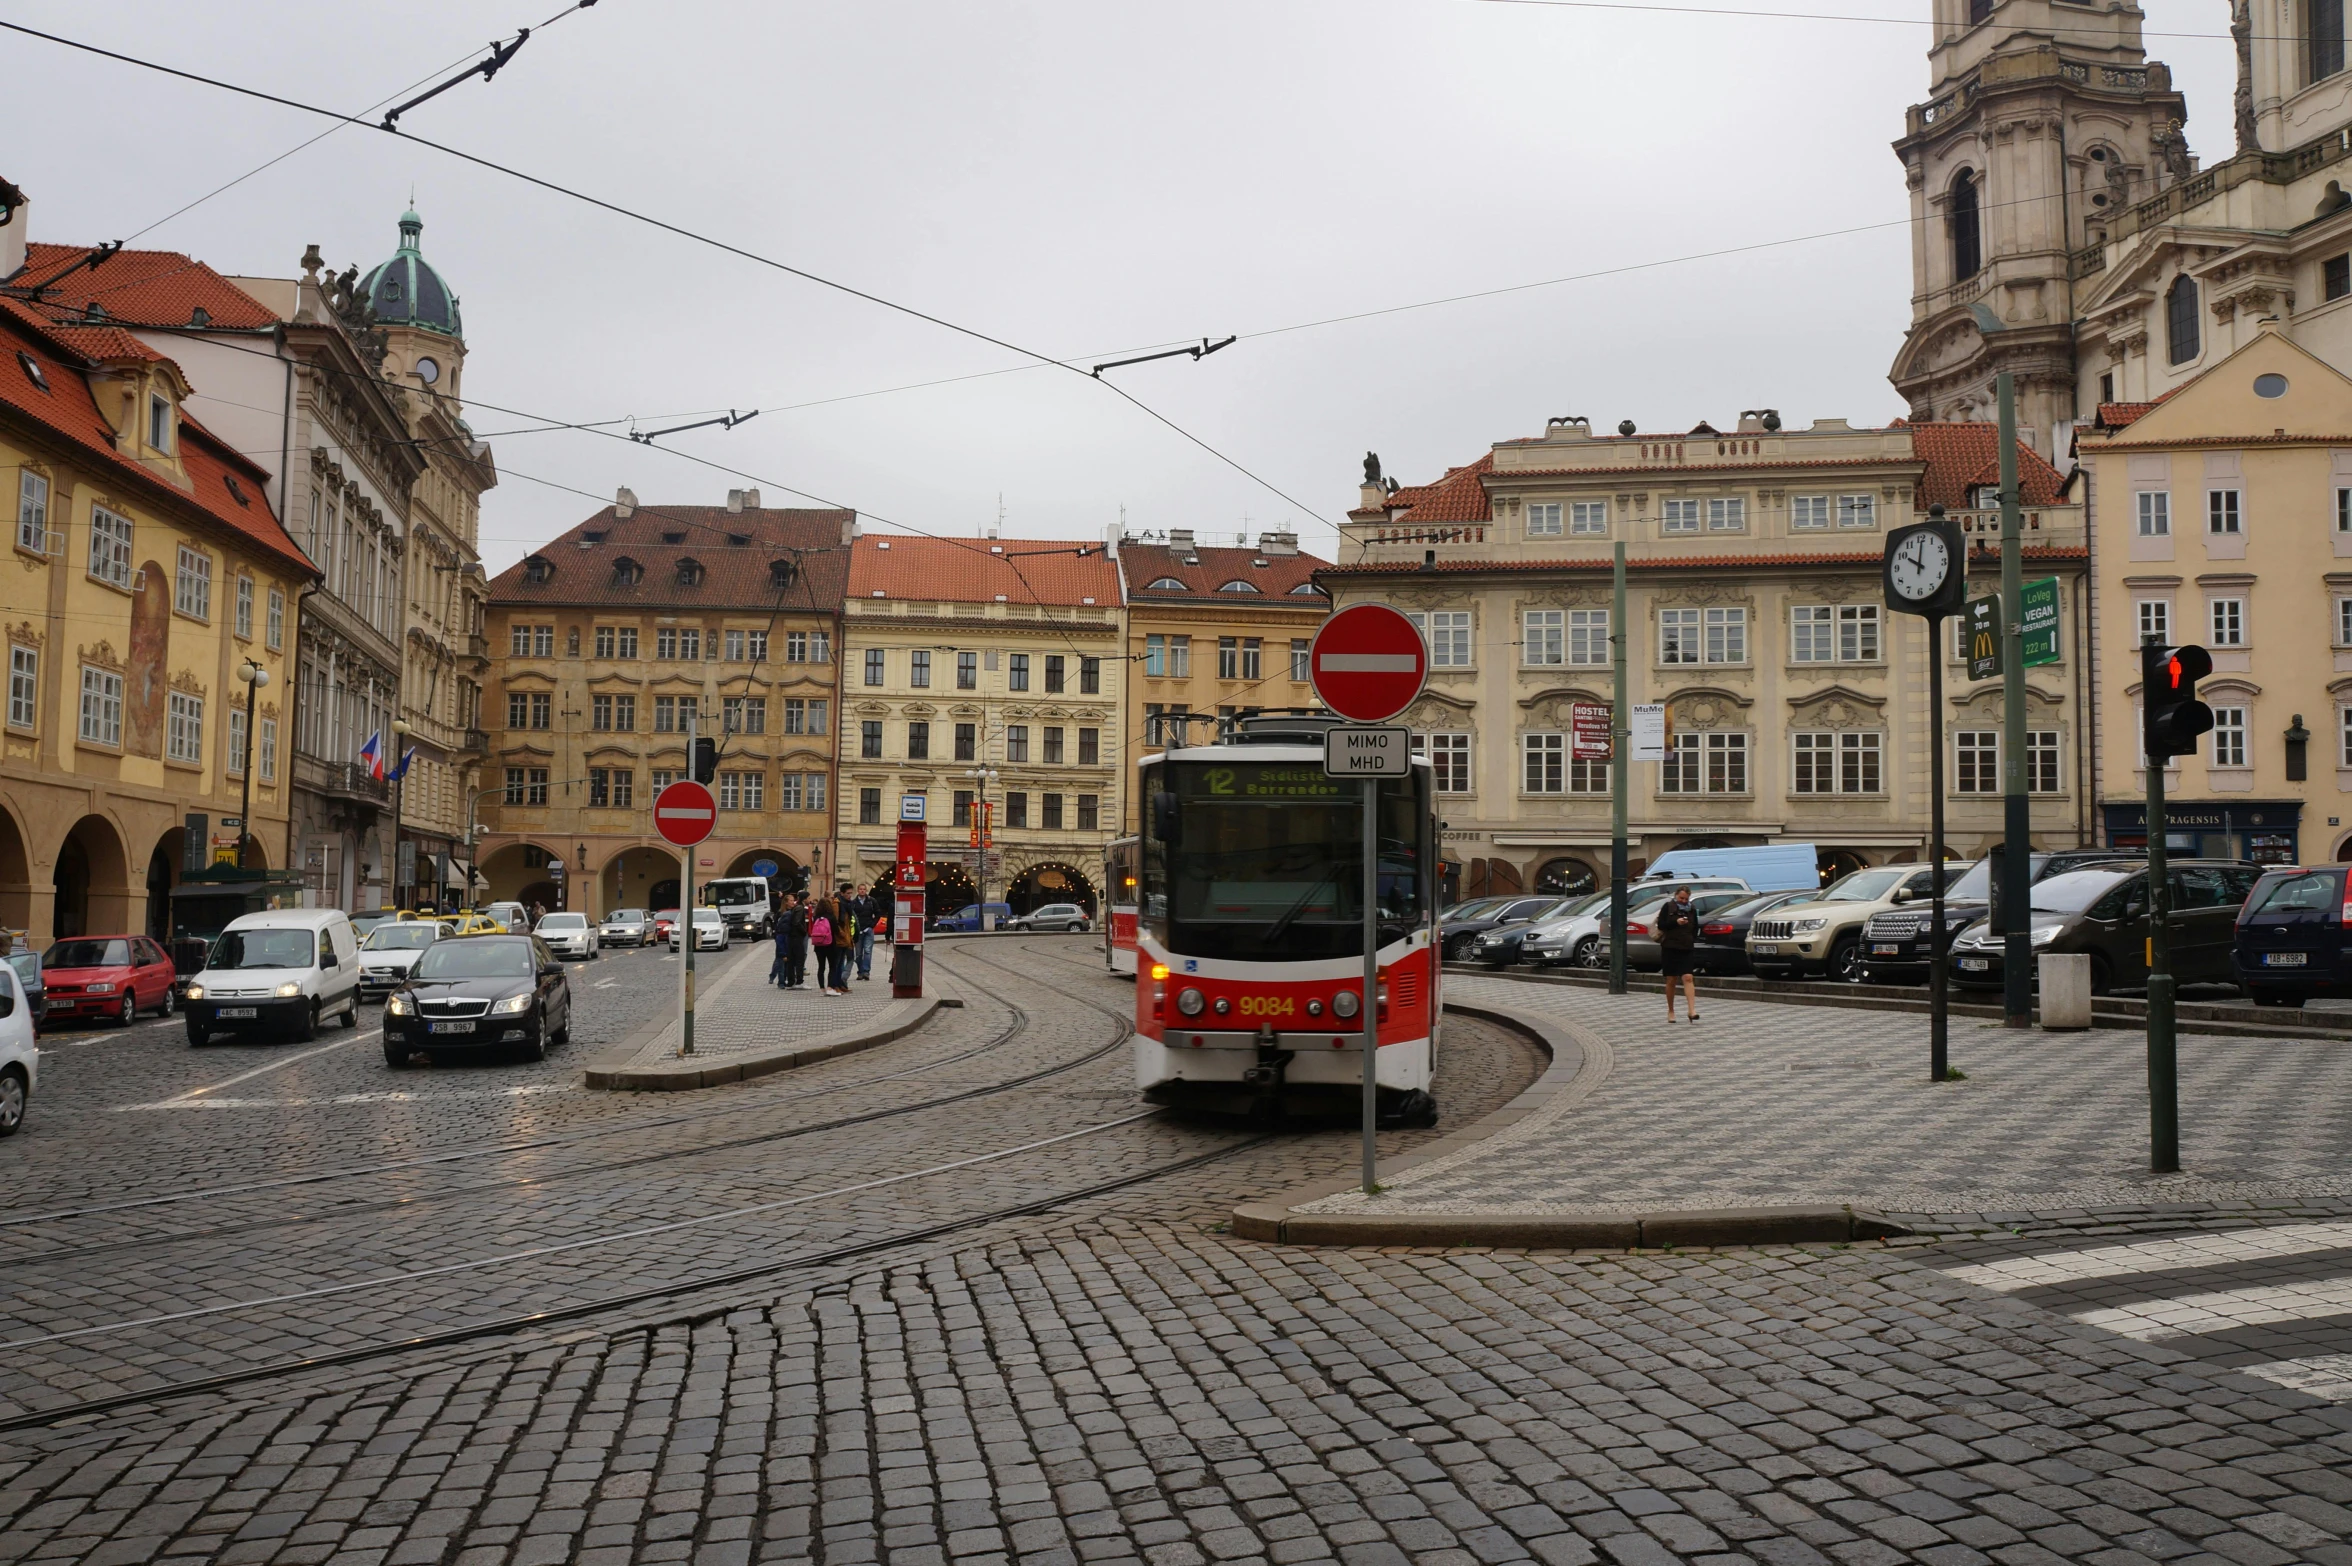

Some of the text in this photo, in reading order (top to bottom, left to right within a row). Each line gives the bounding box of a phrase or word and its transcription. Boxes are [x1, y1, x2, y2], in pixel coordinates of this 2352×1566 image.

[1916, 534, 1926, 543] 12
[1930, 536, 1934, 545] 1
[1906, 541, 1914, 549] 11
[1938, 545, 1944, 553] 2
[1898, 552, 1908, 560] 10
[1941, 558, 1947, 566] 3
[1936, 571, 1942, 580] 4
[1897, 577, 1904, 586] 8
[1906, 586, 1911, 594] 7
[1917, 588, 1923, 596] 6
[2028, 590, 2051, 604] LoVeg
[2025, 604, 2053, 621] VEGAN
[1975, 622, 1983, 630] 70
[2022, 617, 2057, 633] RESTAURANT
[2026, 642, 2048, 655] 222 m
[1575, 706, 1610, 716] HOSTEL
[1348, 735, 1388, 748] MIMO
[1350, 756, 1384, 769] MHD
[1204, 768, 1235, 794] 12
[2269, 953, 2303, 963] 1AB 6982
[1240, 996, 1295, 1015] 9084
